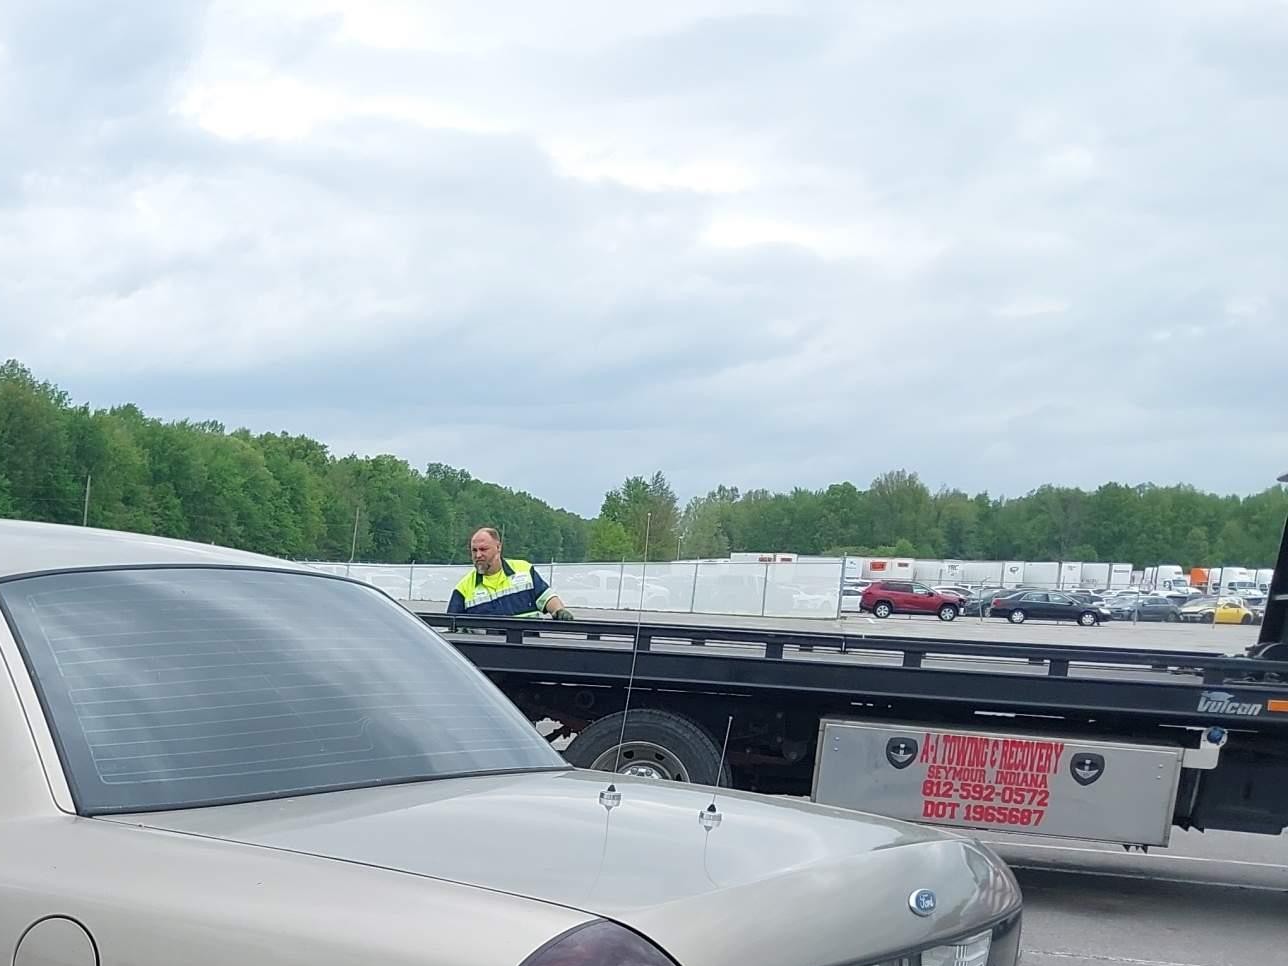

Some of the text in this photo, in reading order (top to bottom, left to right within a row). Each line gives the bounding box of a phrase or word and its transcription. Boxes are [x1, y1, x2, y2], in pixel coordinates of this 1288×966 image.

[1197, 696, 1262, 715] Vulcan
[920, 733, 940, 764] A-1
[942, 734, 989, 768] TOWING
[1000, 739, 1065, 774] RECOVERY
[927, 764, 986, 784] SEYMOUR
[995, 770, 1048, 789] INDIANA
[922, 779, 1050, 807] 812-592-0572
[923, 800, 1045, 827] DOT 1965687
